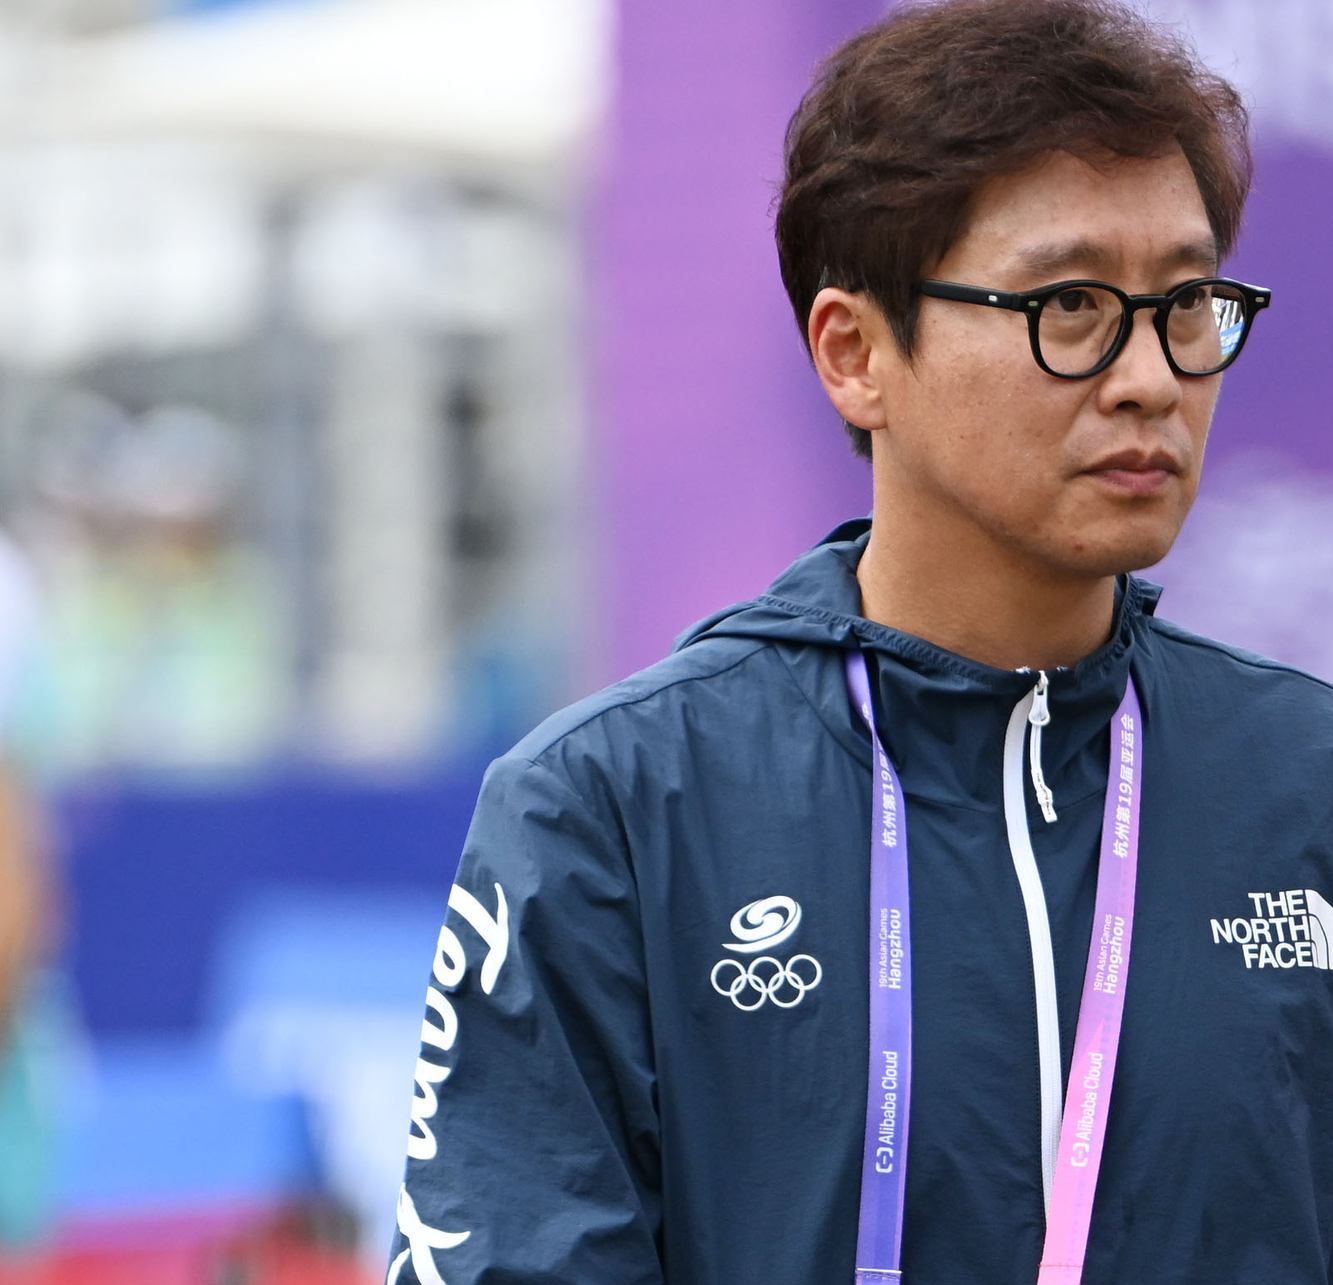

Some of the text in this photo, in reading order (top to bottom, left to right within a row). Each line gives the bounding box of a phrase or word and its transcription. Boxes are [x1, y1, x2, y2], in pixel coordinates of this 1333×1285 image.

[1112, 713, 1134, 859] 杭州第19届亚运会
[1210, 915, 1310, 944] NORTH
[1248, 889, 1306, 917] THE
[879, 908, 888, 988] 19th Asian Games
[889, 908, 903, 989] Hangzhou
[1094, 914, 1112, 991] 19th Asian Games
[1103, 916, 1125, 994] Hangzhou
[1242, 941, 1313, 968] FACE
[407, 882, 508, 1160] Team
[878, 1051, 897, 1145] Alibaba Cloud
[1077, 1052, 1103, 1140] Alibaba Cloud
